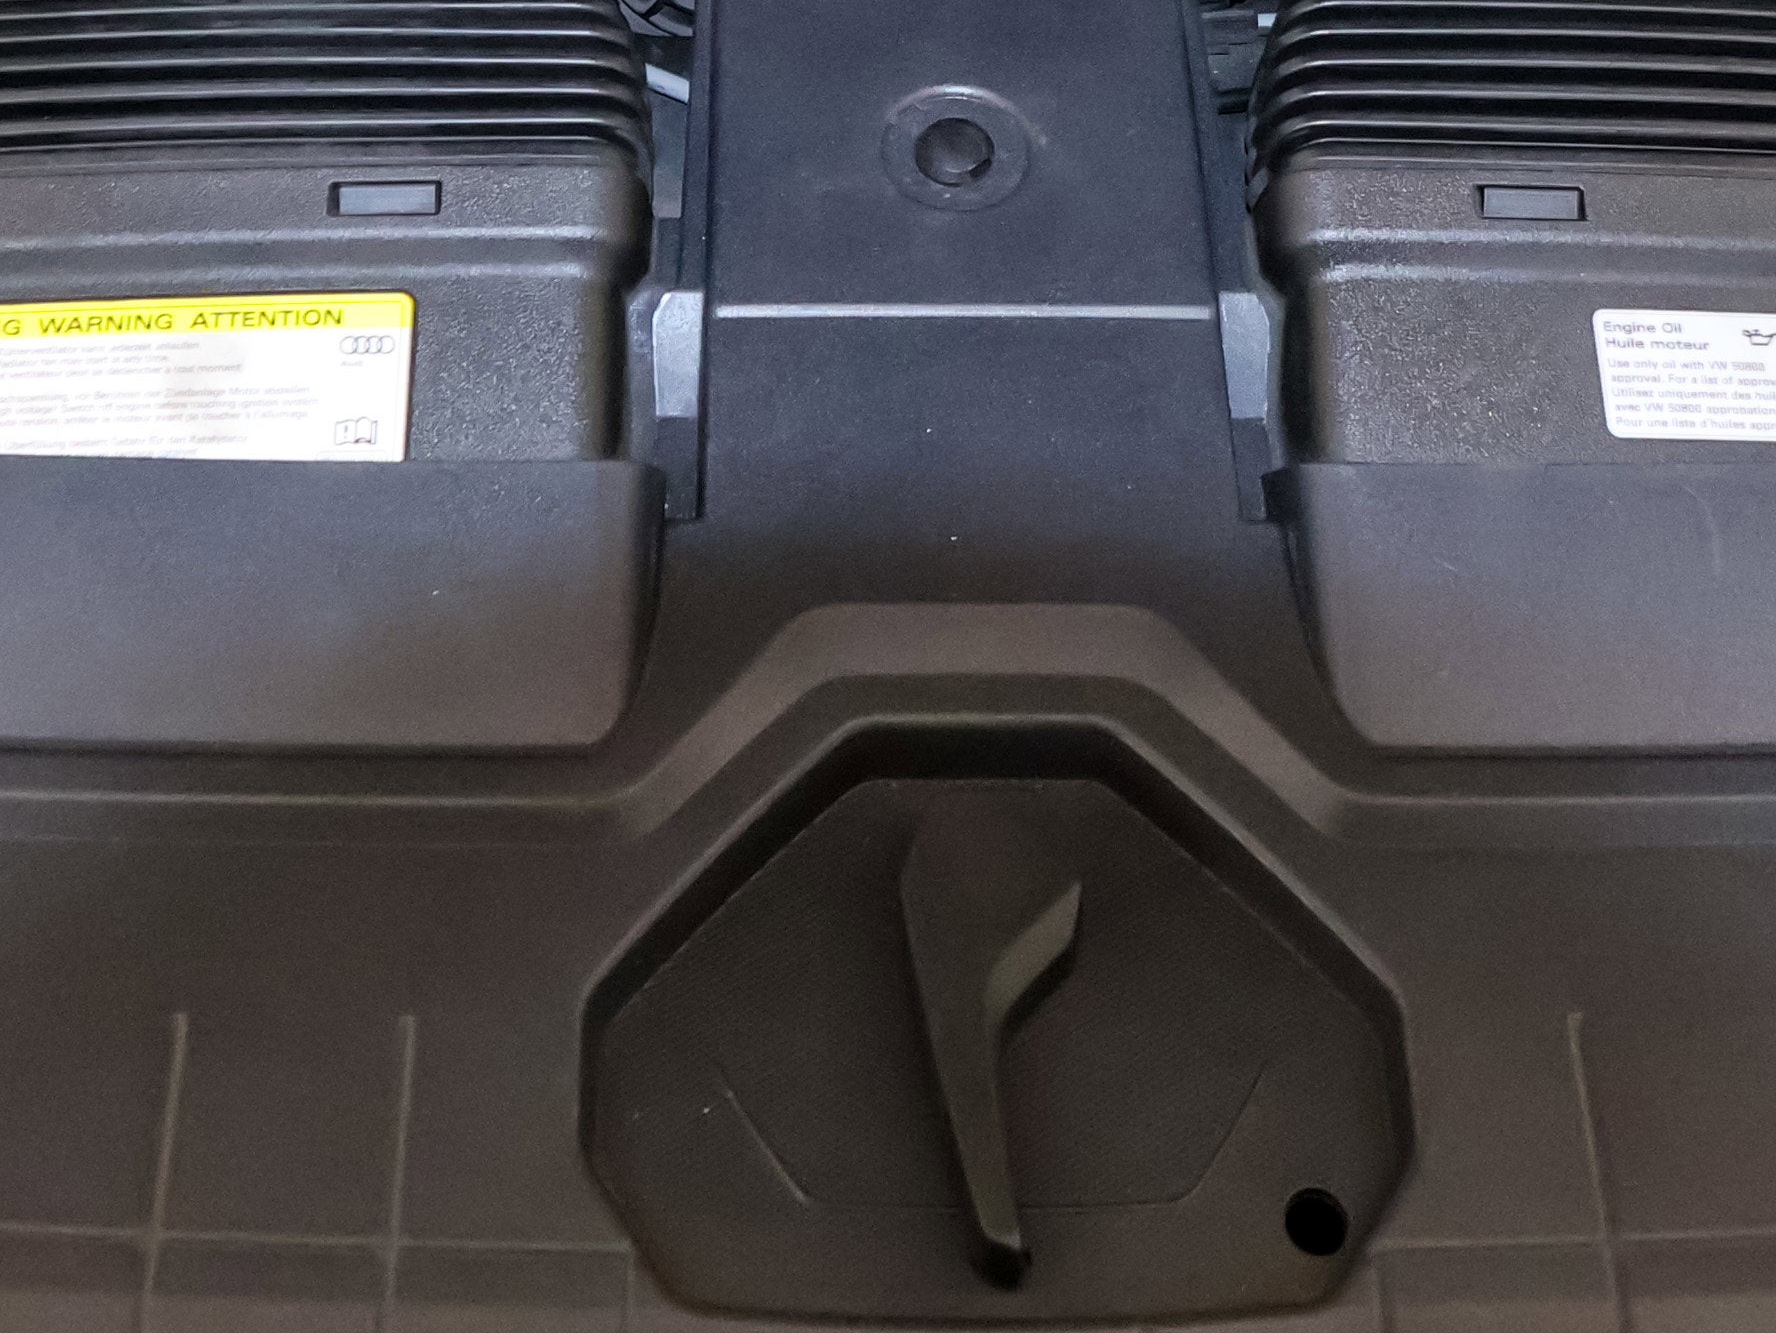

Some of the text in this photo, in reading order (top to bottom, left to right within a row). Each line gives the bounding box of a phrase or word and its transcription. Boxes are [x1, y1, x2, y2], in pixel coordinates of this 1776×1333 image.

[40, 312, 173, 335] WARNING
[190, 308, 343, 331] ATTENTION
[1603, 321, 1682, 334] Engine Oil
[1605, 337, 1709, 351] Huile moteur
[1680, 361, 1704, 370] with
[1708, 361, 1727, 370] VW
[1644, 403, 1664, 412] VW
